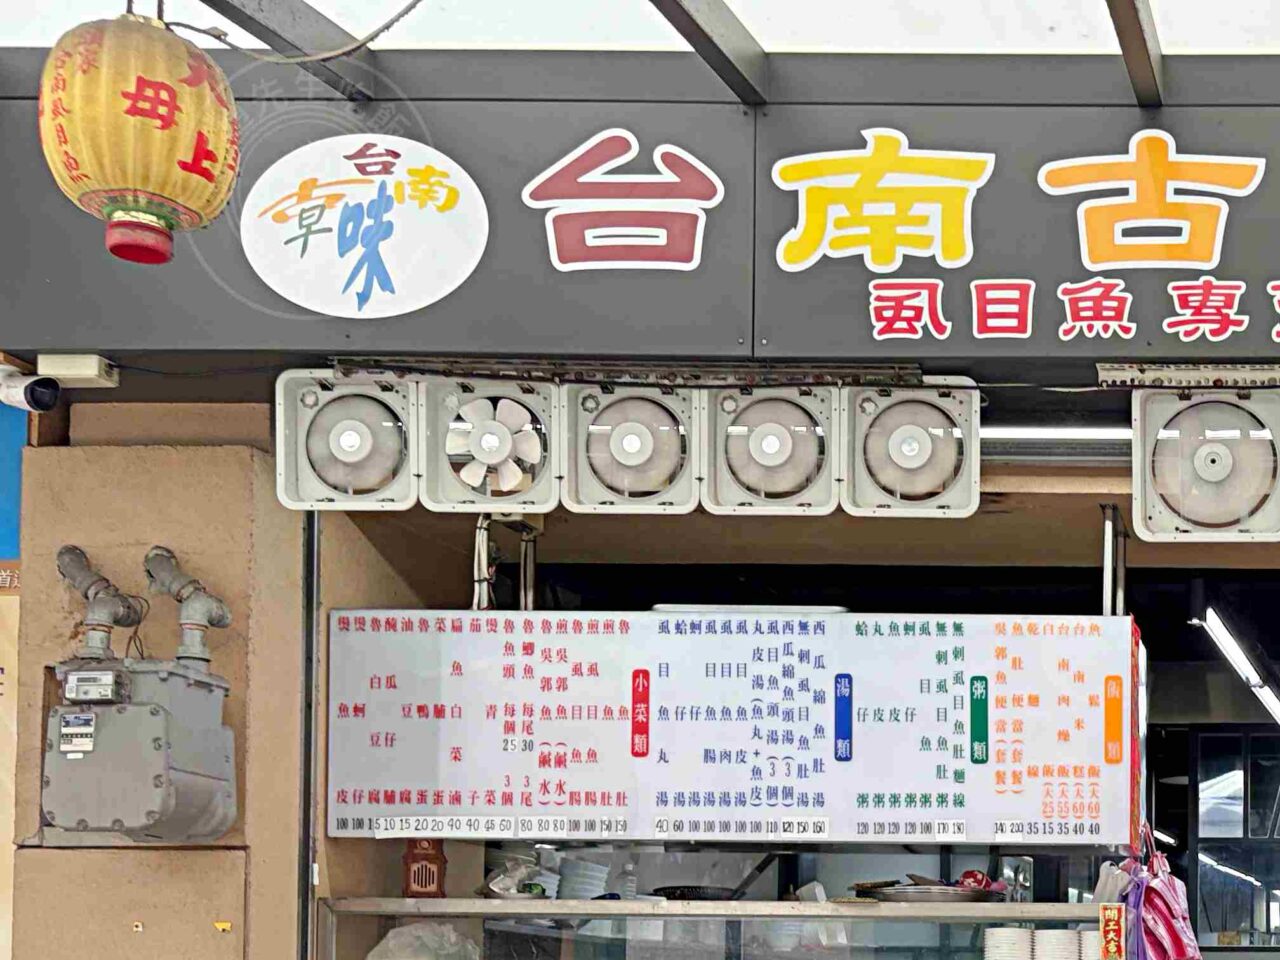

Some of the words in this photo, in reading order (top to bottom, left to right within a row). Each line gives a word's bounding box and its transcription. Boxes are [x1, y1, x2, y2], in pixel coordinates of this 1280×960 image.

[121, 75, 183, 131] 母
[468, 617, 481, 805] 茄子
[634, 673, 648, 752] 小菜類
[656, 620, 670, 808] 虱目魚丸湯
[836, 677, 851, 758] 湯類
[972, 680, 987, 760] 粥類
[673, 820, 684, 833] 60
[688, 820, 700, 833] 100
[703, 820, 716, 833] 100
[718, 820, 731, 833] 100
[734, 820, 747, 833] 100
[750, 820, 762, 833] 100
[1027, 822, 1039, 835] 35
[1042, 822, 1054, 835] 15
[1057, 822, 1070, 835] 35
[1072, 822, 1085, 835] 40
[1088, 822, 1100, 835] 40
